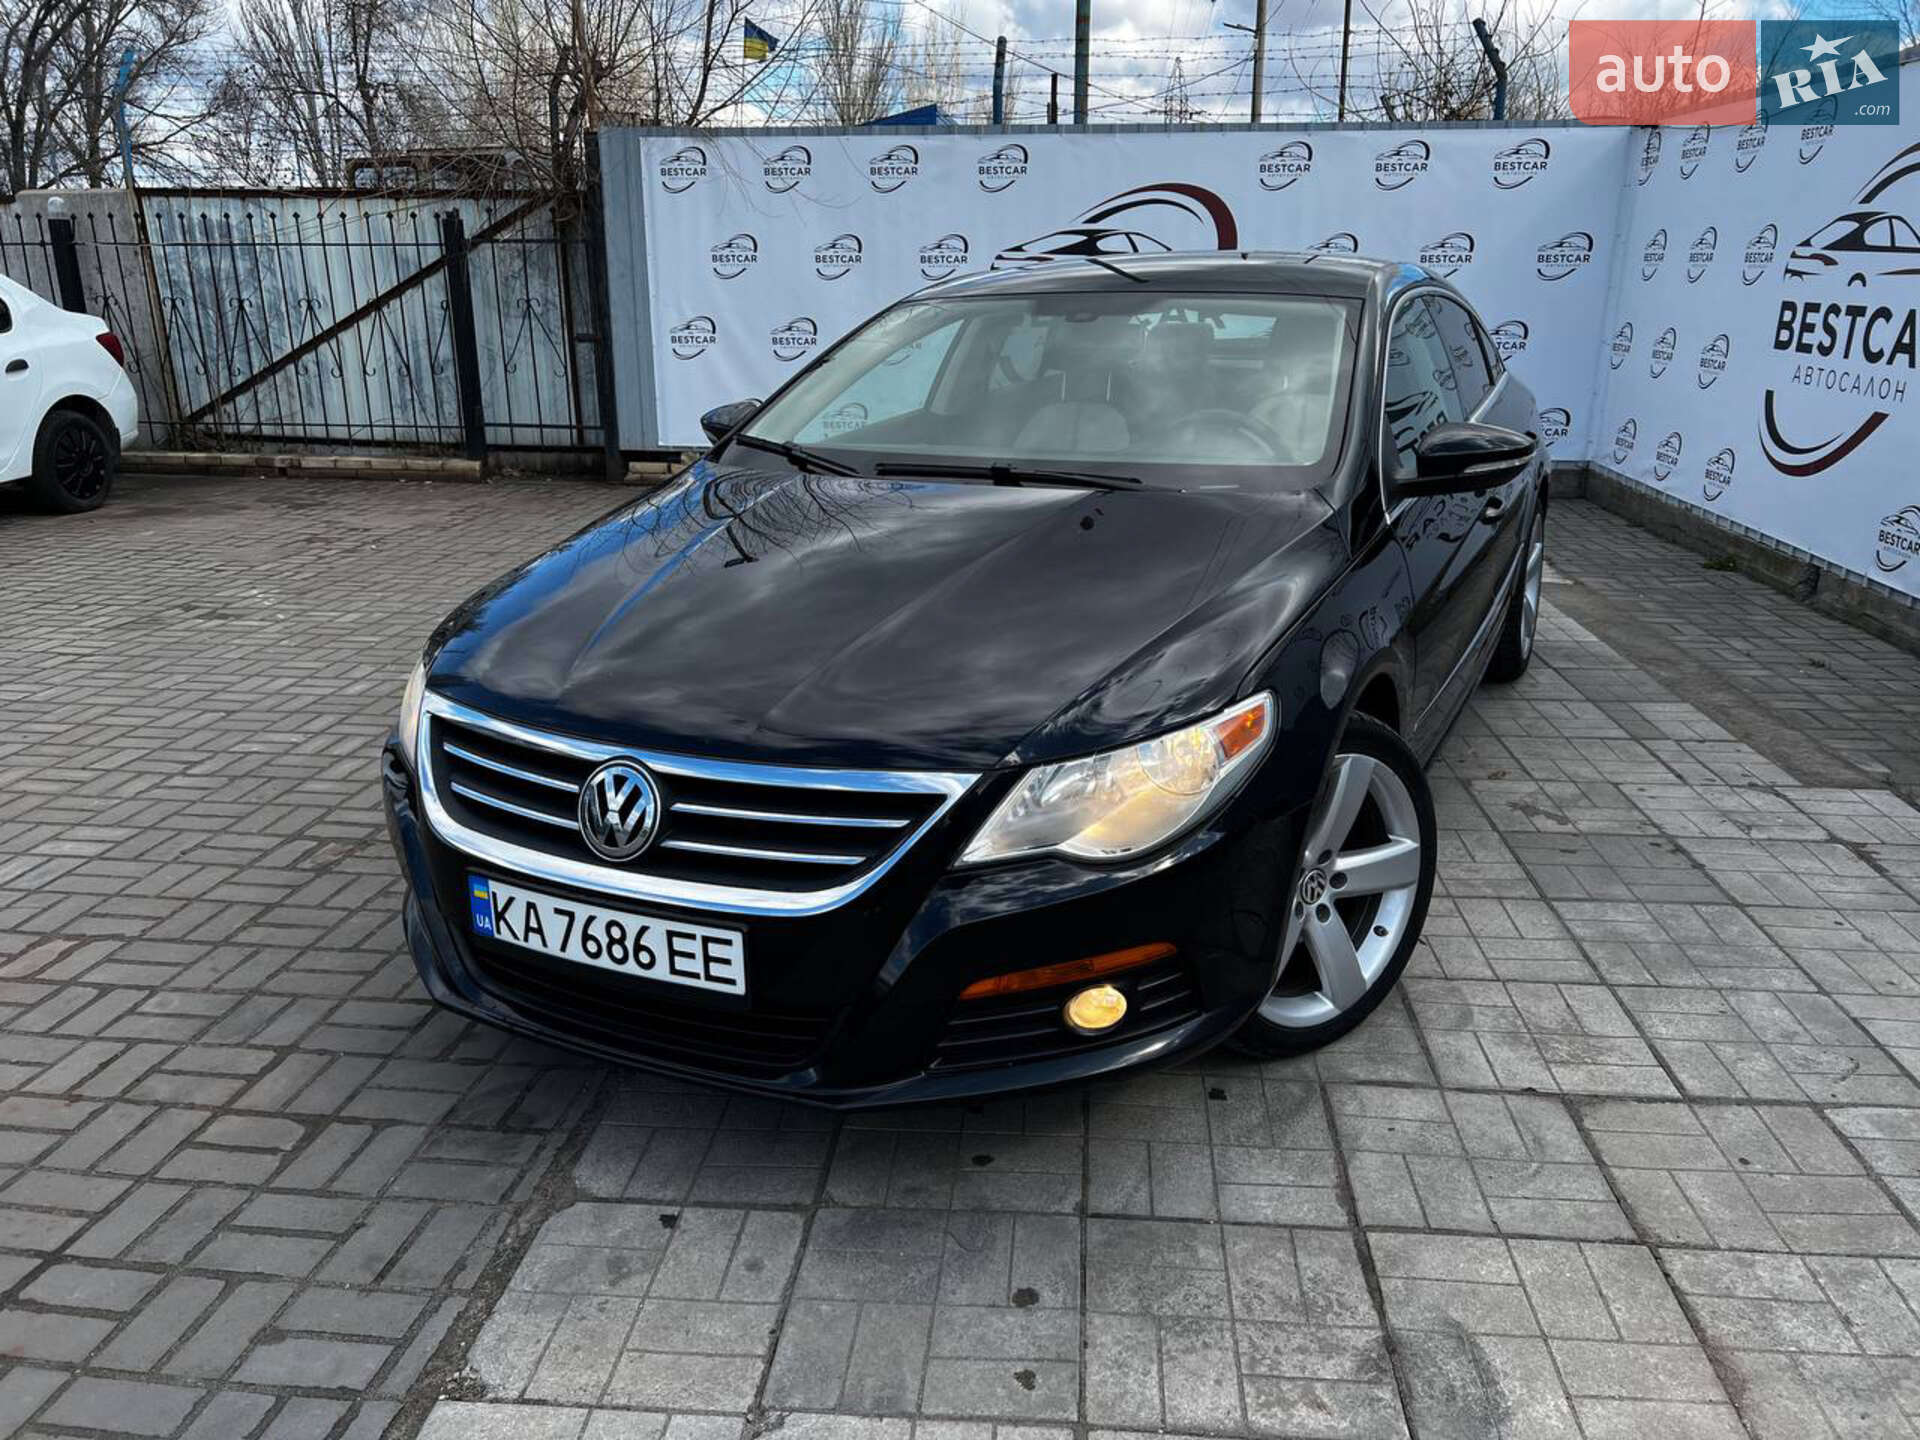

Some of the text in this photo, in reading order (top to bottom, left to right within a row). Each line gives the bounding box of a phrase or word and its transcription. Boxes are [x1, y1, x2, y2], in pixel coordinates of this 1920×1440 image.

[660, 166, 707, 177] BESTCAR
[764, 166, 811, 177] BESTCAR
[870, 165, 918, 176] BESTCAR
[978, 164, 1027, 176] BESTCAR
[1259, 161, 1311, 174] BESTCAR
[1375, 161, 1428, 173] BESTCAR
[1494, 160, 1548, 172] BESTCAR
[711, 253, 758, 264] BESTCAR
[815, 253, 862, 264] BESTCAR
[920, 254, 968, 265] BESTCAR
[1420, 253, 1472, 265] BESTCAR
[1537, 252, 1591, 265] BESTCAR
[671, 334, 716, 345] BESTCAR
[1773, 300, 1917, 369] BESTCA
[772, 336, 817, 347] BESTCAR
[1496, 341, 1527, 351] TCAR
[1792, 364, 1907, 403] АВТОСАЛОН
[475, 913, 492, 931] UA
